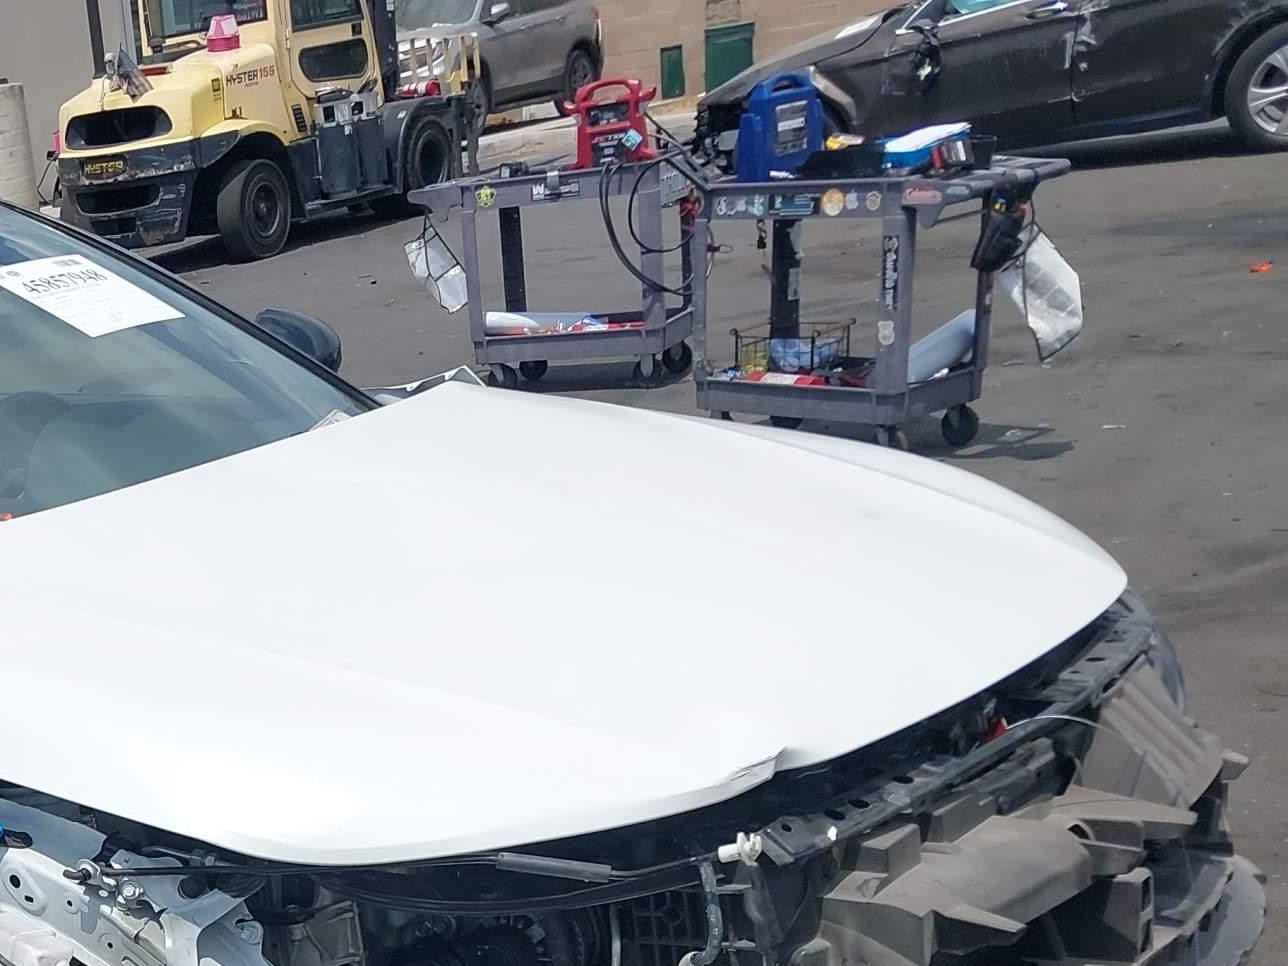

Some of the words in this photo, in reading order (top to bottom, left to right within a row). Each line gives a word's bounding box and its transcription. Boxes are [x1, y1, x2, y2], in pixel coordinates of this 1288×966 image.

[225, 69, 259, 87] HYSTER
[259, 65, 276, 80] 155
[22, 269, 109, 294] 45857948
